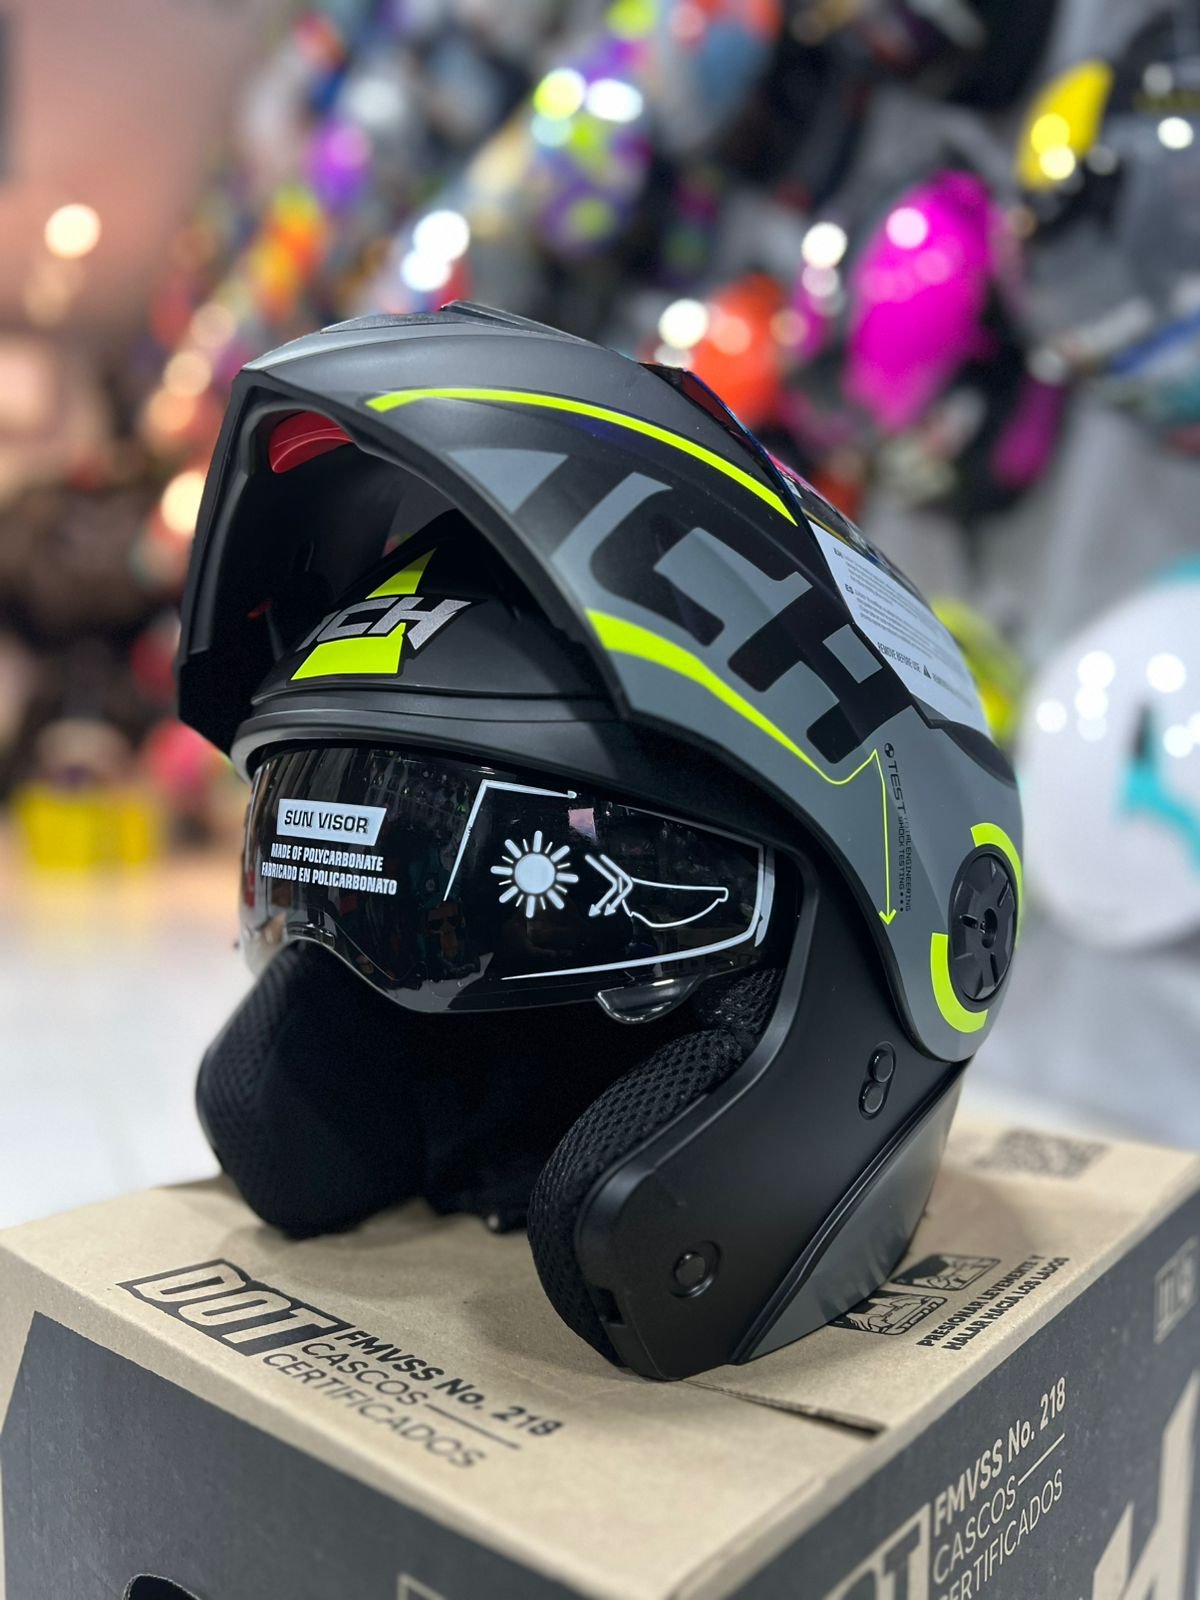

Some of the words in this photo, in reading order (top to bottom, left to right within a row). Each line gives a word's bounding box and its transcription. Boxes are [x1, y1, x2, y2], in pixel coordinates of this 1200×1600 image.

[284, 809, 314, 828] SUN
[318, 812, 369, 834] VISOR
[888, 760, 906, 815] TEST
[261, 862, 297, 881] FABRICADO
[298, 867, 310, 883] EN
[312, 869, 397, 896] POLICARBONATO
[271, 842, 291, 859] MADE
[292, 845, 302, 861] OF
[303, 847, 384, 872] POLYCARBONATE
[916, 1296, 989, 1347] PRESIONAR
[980, 1258, 1040, 1301] LEVEMENTE
[941, 1319, 993, 1351] HALAR
[979, 1294, 1024, 1320] HACIA
[1012, 1279, 1042, 1295] LOS
[1032, 1256, 1070, 1281] LADOS
[128, 1262, 342, 1346] DOT
[334, 1330, 445, 1382] FMVSS
[434, 1377, 486, 1410] No.
[492, 1405, 564, 1437] 218
[301, 1342, 428, 1406] CASCOS
[262, 1353, 488, 1469] CERTIFICADOS
[934, 1439, 1003, 1537] FMVSS
[1008, 1419, 1035, 1464] No.
[1040, 1377, 1066, 1430] 218
[933, 1475, 1016, 1585] CASCOS
[938, 1468, 1064, 1600] ERTIFICADOS
